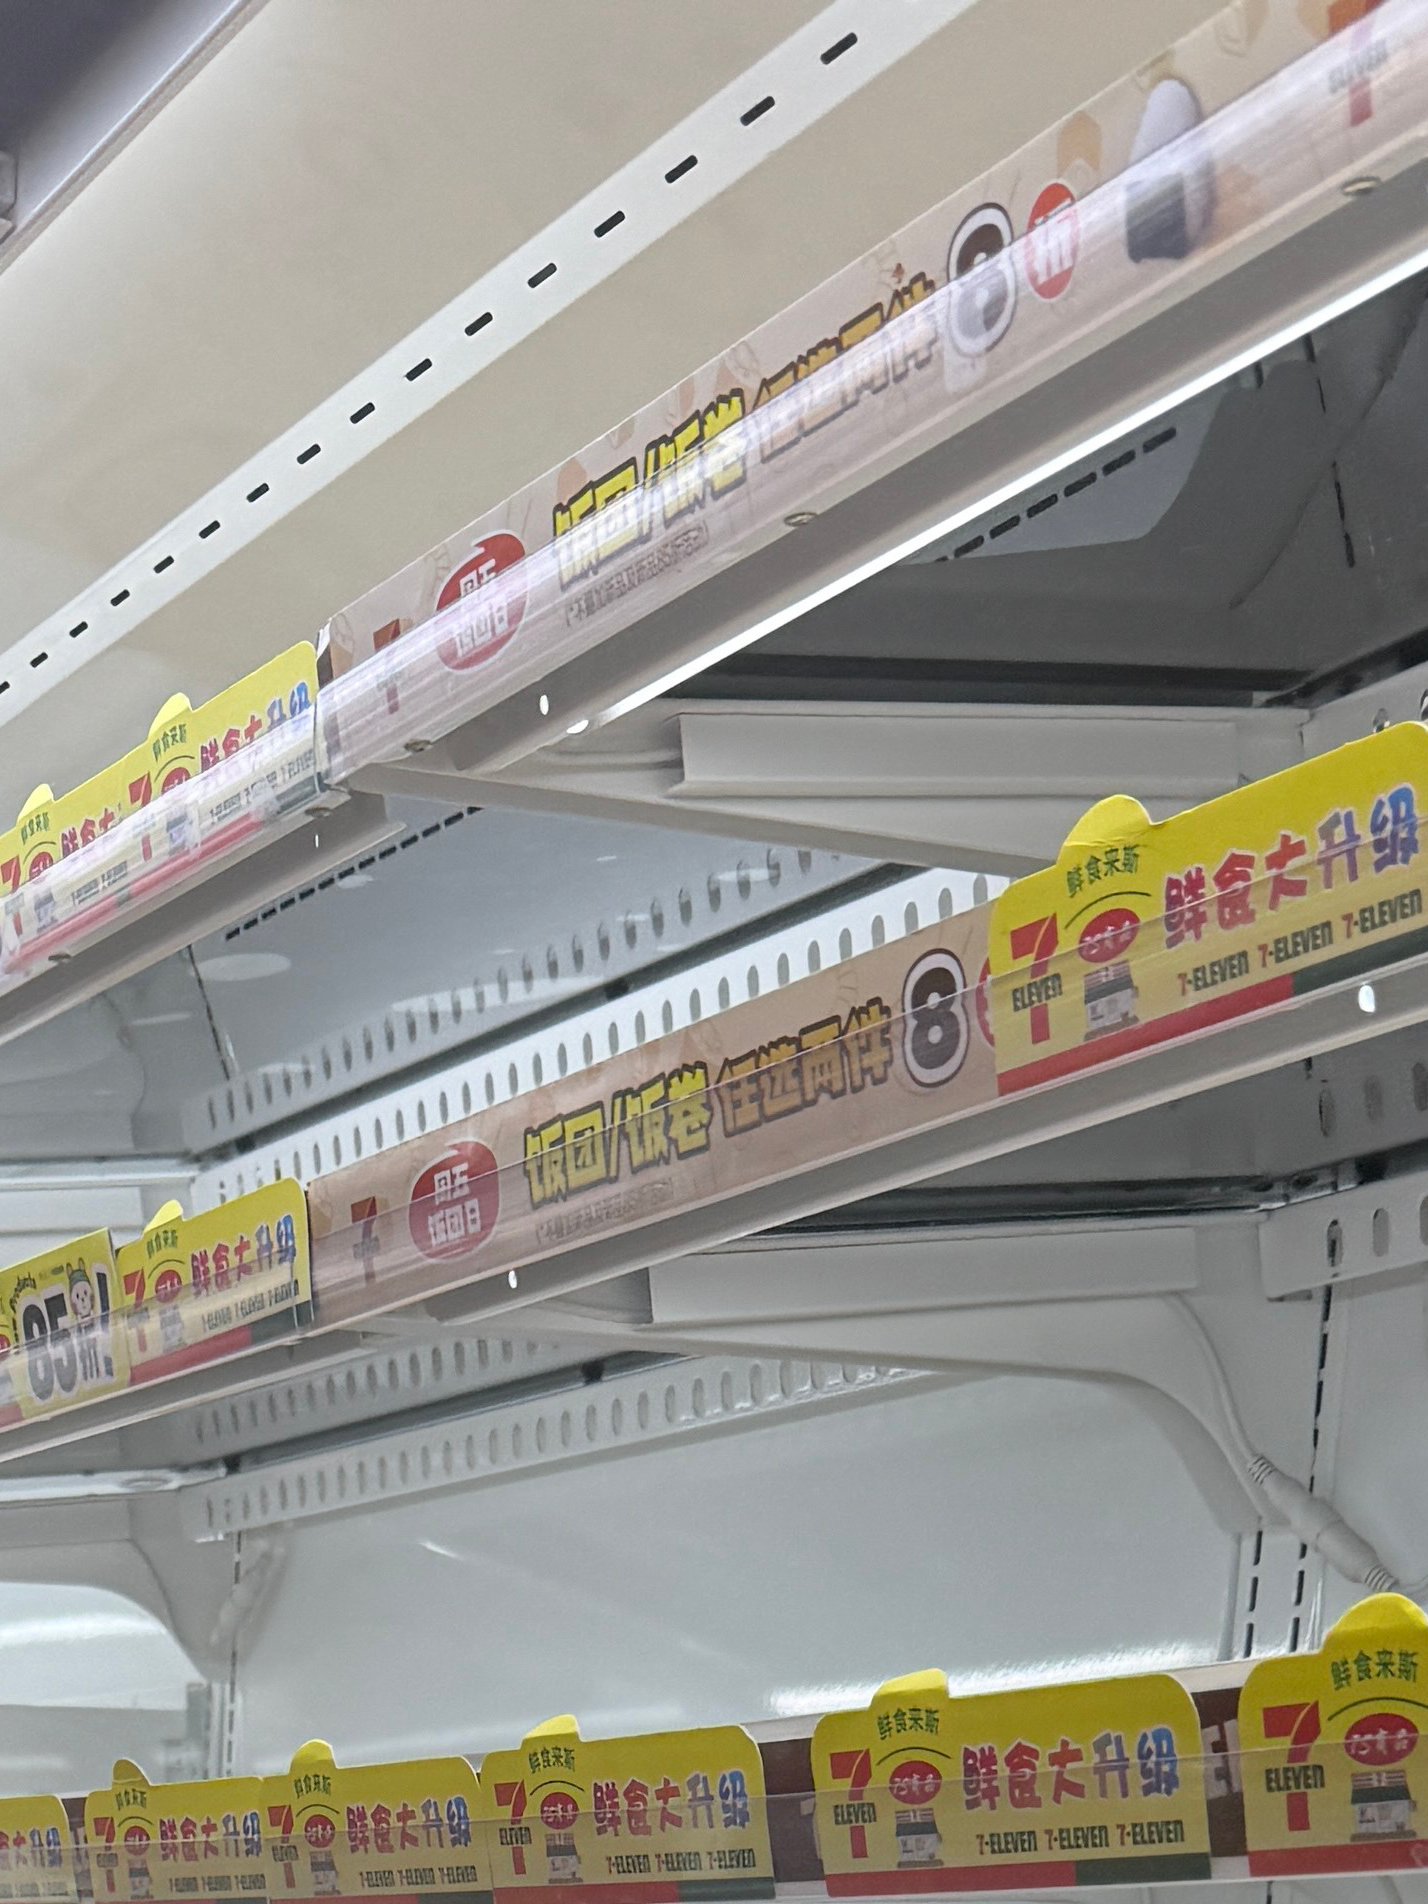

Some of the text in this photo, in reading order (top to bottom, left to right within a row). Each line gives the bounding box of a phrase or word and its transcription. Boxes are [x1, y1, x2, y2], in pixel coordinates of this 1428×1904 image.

[1065, 845, 1141, 900] 鲜食来斯
[1162, 784, 1420, 948] 鲜食大升级
[903, 947, 968, 1087] 8
[1009, 912, 1060, 1045] 7
[522, 948, 968, 1208] 饭团/饭卷 任选两件 8
[1331, 1650, 1419, 1691] 鲜食来斯
[529, 1748, 575, 1774] 鲜食来斯
[877, 1708, 940, 1739] 鲜食来斯
[591, 1771, 749, 1837] 鲜食大升级
[830, 1749, 872, 1859] 7
[961, 1727, 1180, 1811] 鲜食大升级
[1263, 1702, 1320, 1831] 7
[158, 1811, 260, 1861] 鲜食大升级
[268, 1805, 293, 1888] 7
[346, 1796, 471, 1852] 鲜食大升级
[494, 1782, 527, 1876] 7
